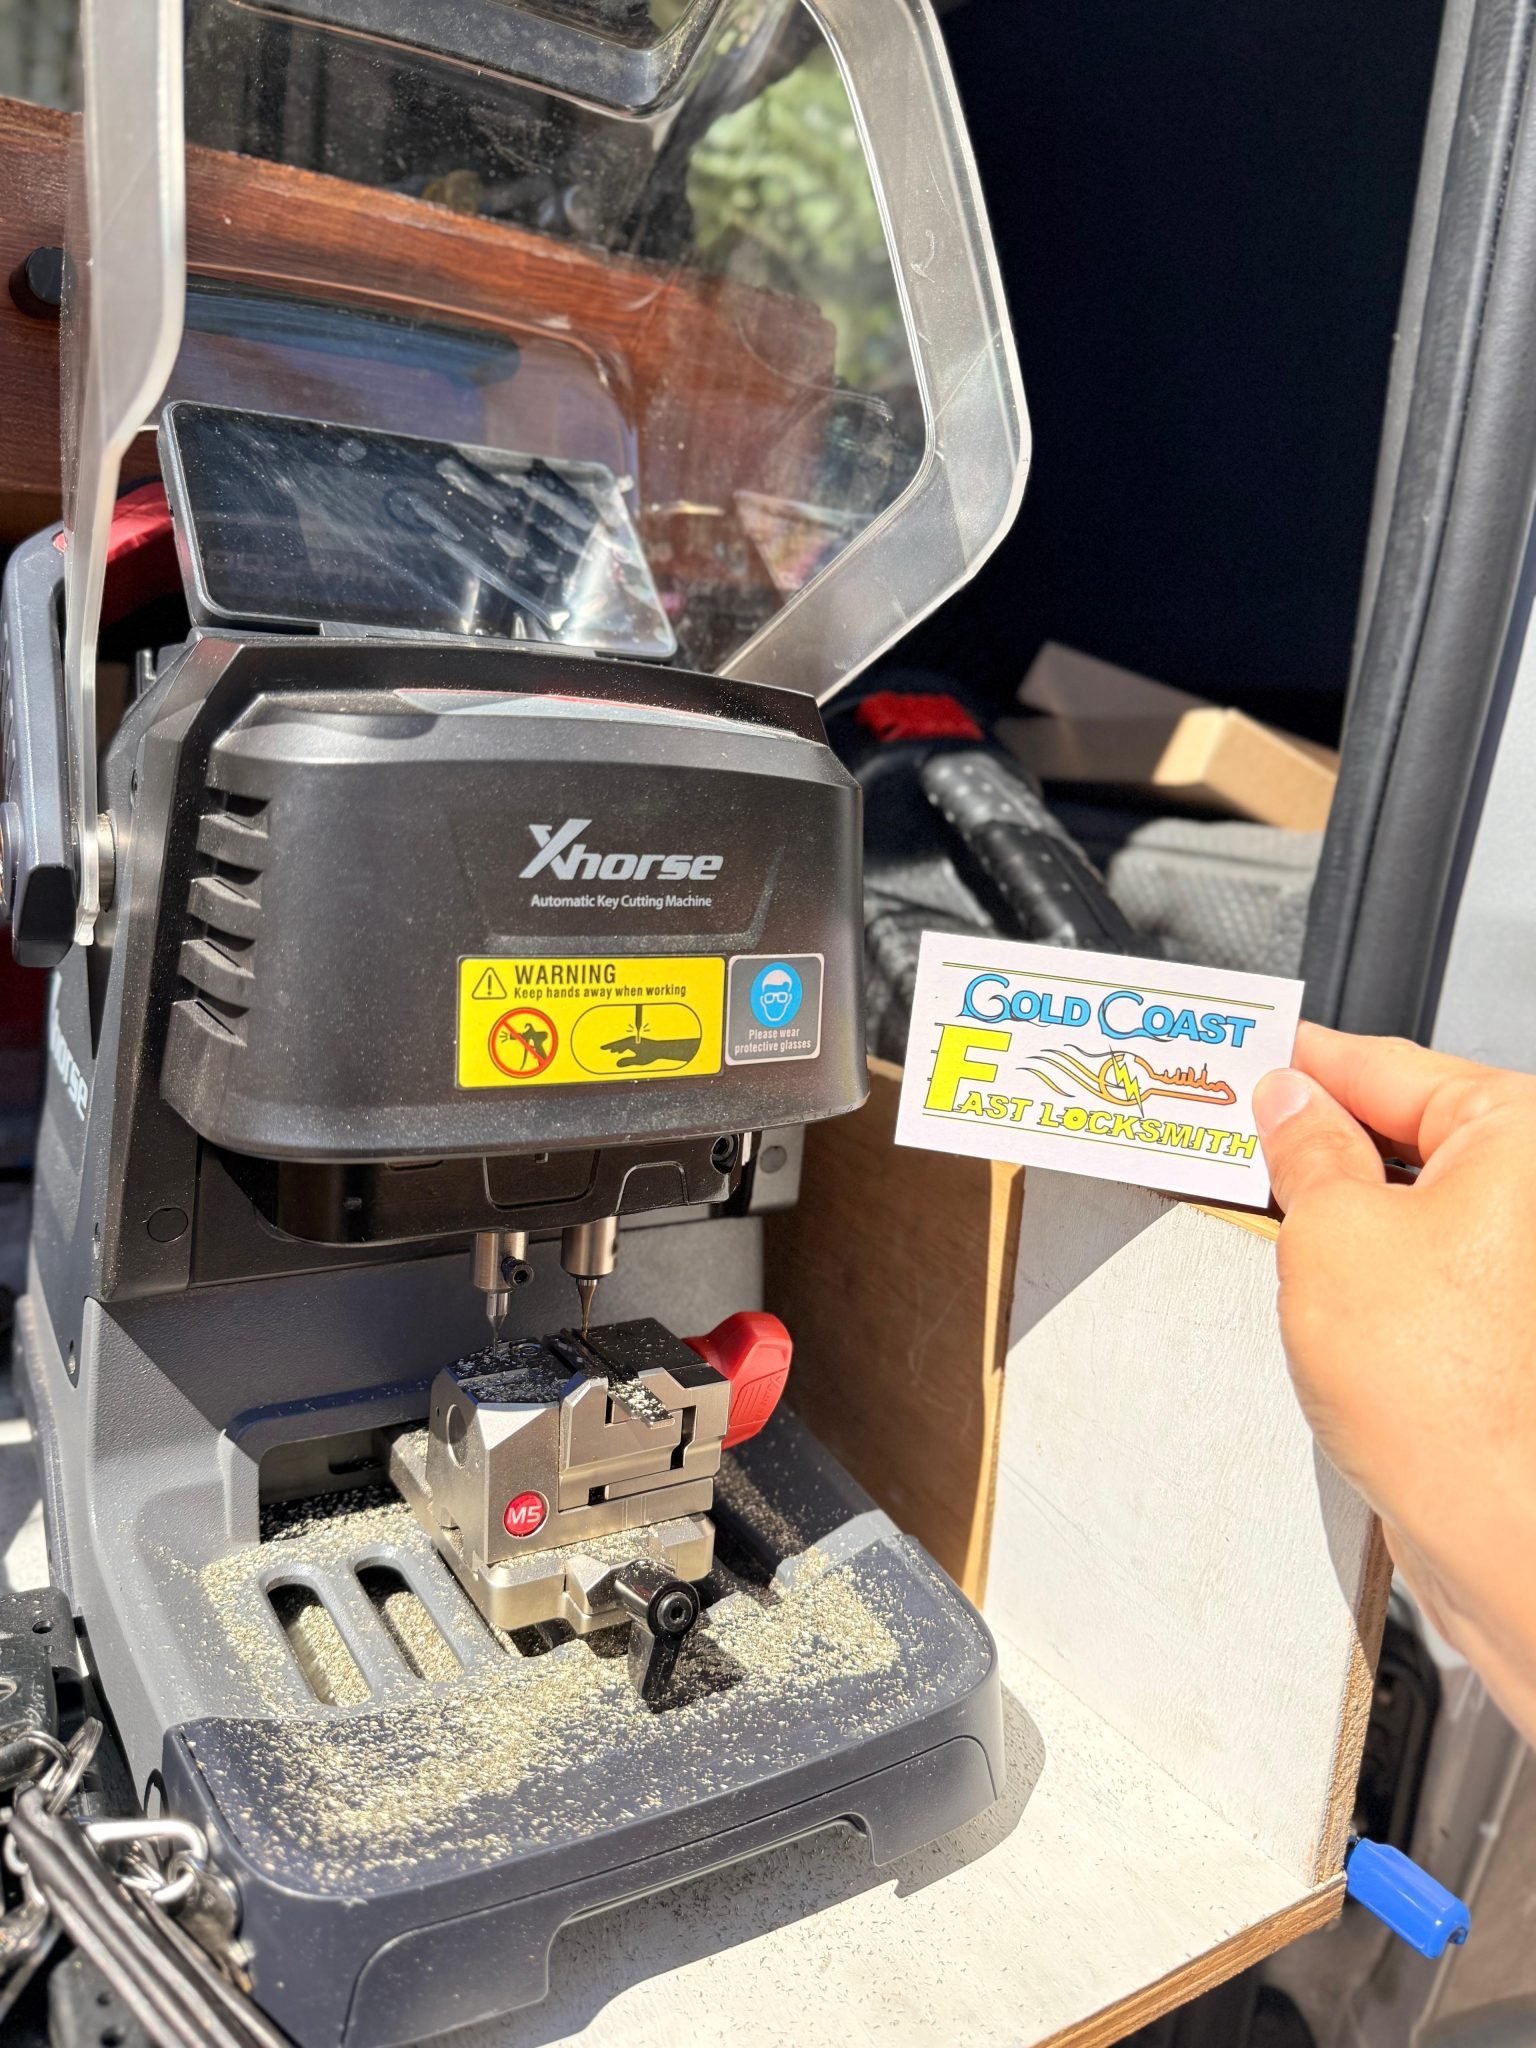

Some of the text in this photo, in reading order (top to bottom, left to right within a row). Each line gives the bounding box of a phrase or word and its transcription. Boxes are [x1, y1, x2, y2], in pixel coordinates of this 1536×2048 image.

[519, 818, 724, 881] Xhorse
[530, 894, 712, 910] Automatic Key Cutting Machine
[514, 964, 616, 985] WARNING
[514, 984, 686, 1000] Keep hands away when working
[956, 973, 1256, 1048] GOLD COAST
[748, 1028, 800, 1040] Please wear
[734, 1039, 811, 1056] protective glasses
[923, 1022, 1258, 1160] FAST LOCKSMITH
[507, 1505, 542, 1525] M5
